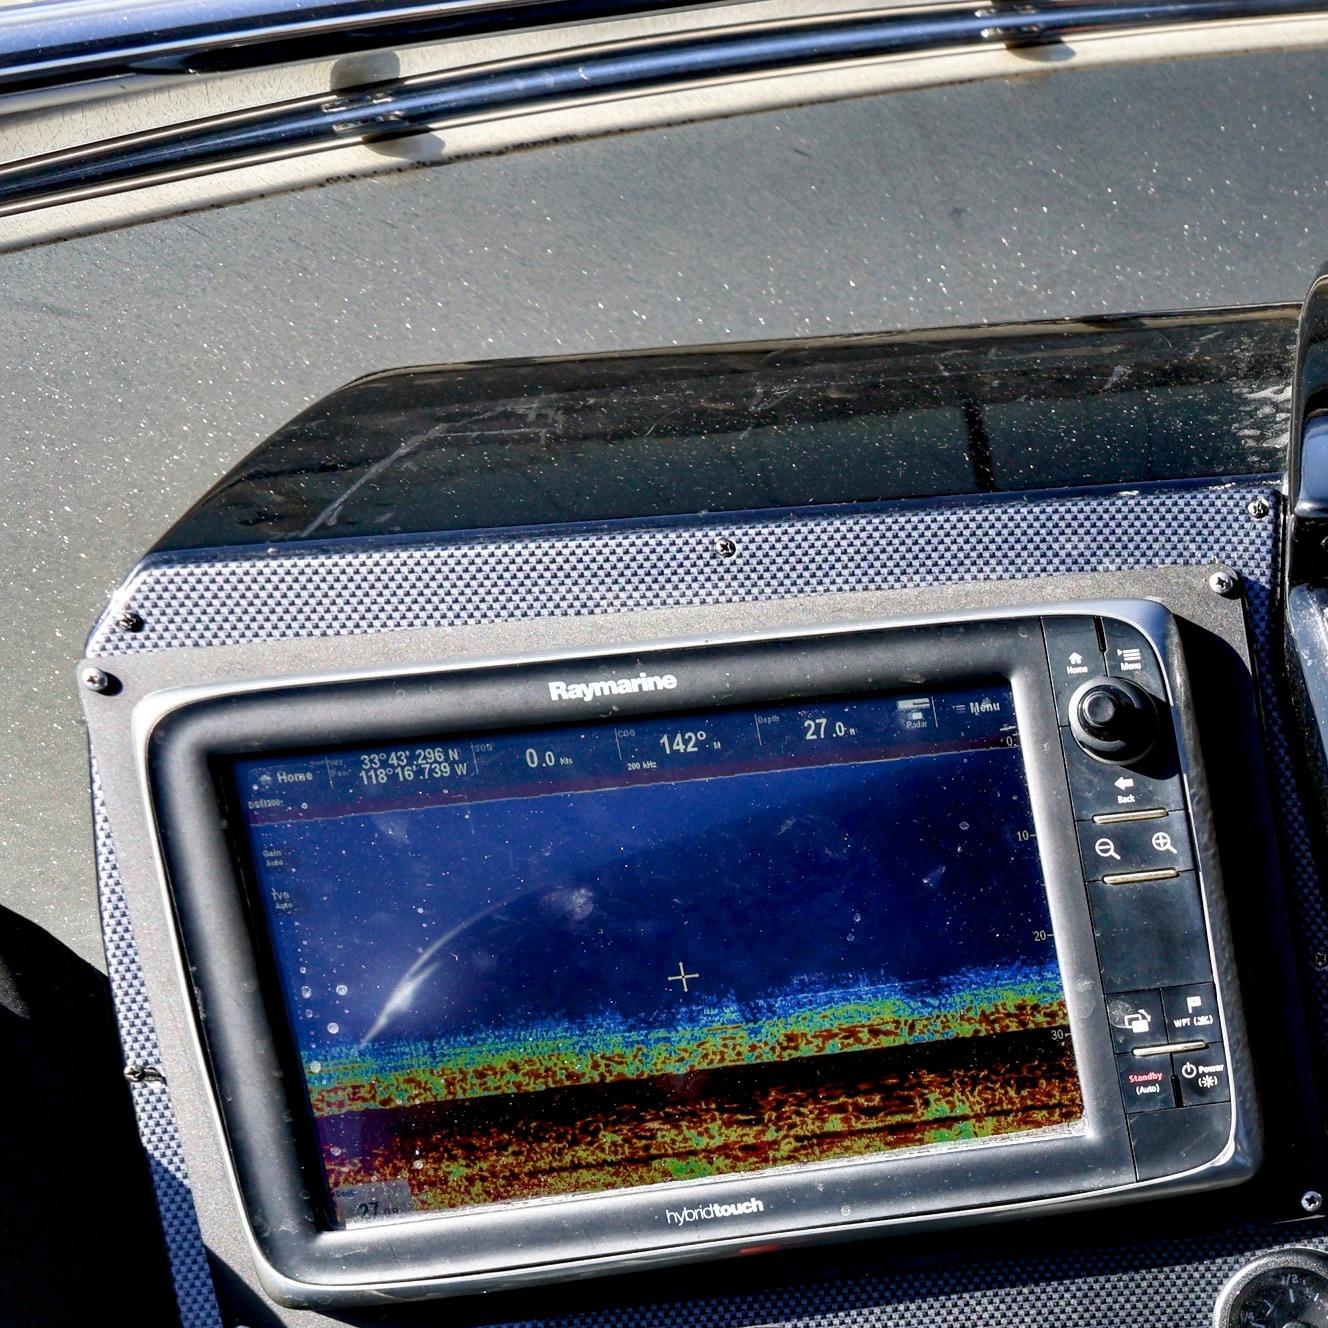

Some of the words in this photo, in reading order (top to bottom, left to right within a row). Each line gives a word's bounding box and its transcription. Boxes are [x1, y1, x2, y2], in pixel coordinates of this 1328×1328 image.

[1067, 665, 1088, 674] Home
[1121, 662, 1141, 671] Menu
[548, 672, 678, 701] Raymarine
[970, 701, 1001, 715] Menu
[757, 714, 780, 725] Depth
[448, 749, 459, 761] N
[454, 763, 468, 777] W
[627, 762, 641, 771] 200
[277, 769, 314, 784] Home
[1118, 795, 1135, 804] Back
[1033, 929, 1048, 942] 20
[1174, 1018, 1191, 1028] WPT
[1050, 1027, 1065, 1042] 30
[1199, 1064, 1225, 1074] Power
[1128, 1072, 1163, 1084] Standby
[1136, 1084, 1160, 1095] (Auto)
[665, 1197, 764, 1227] hybridtouch
